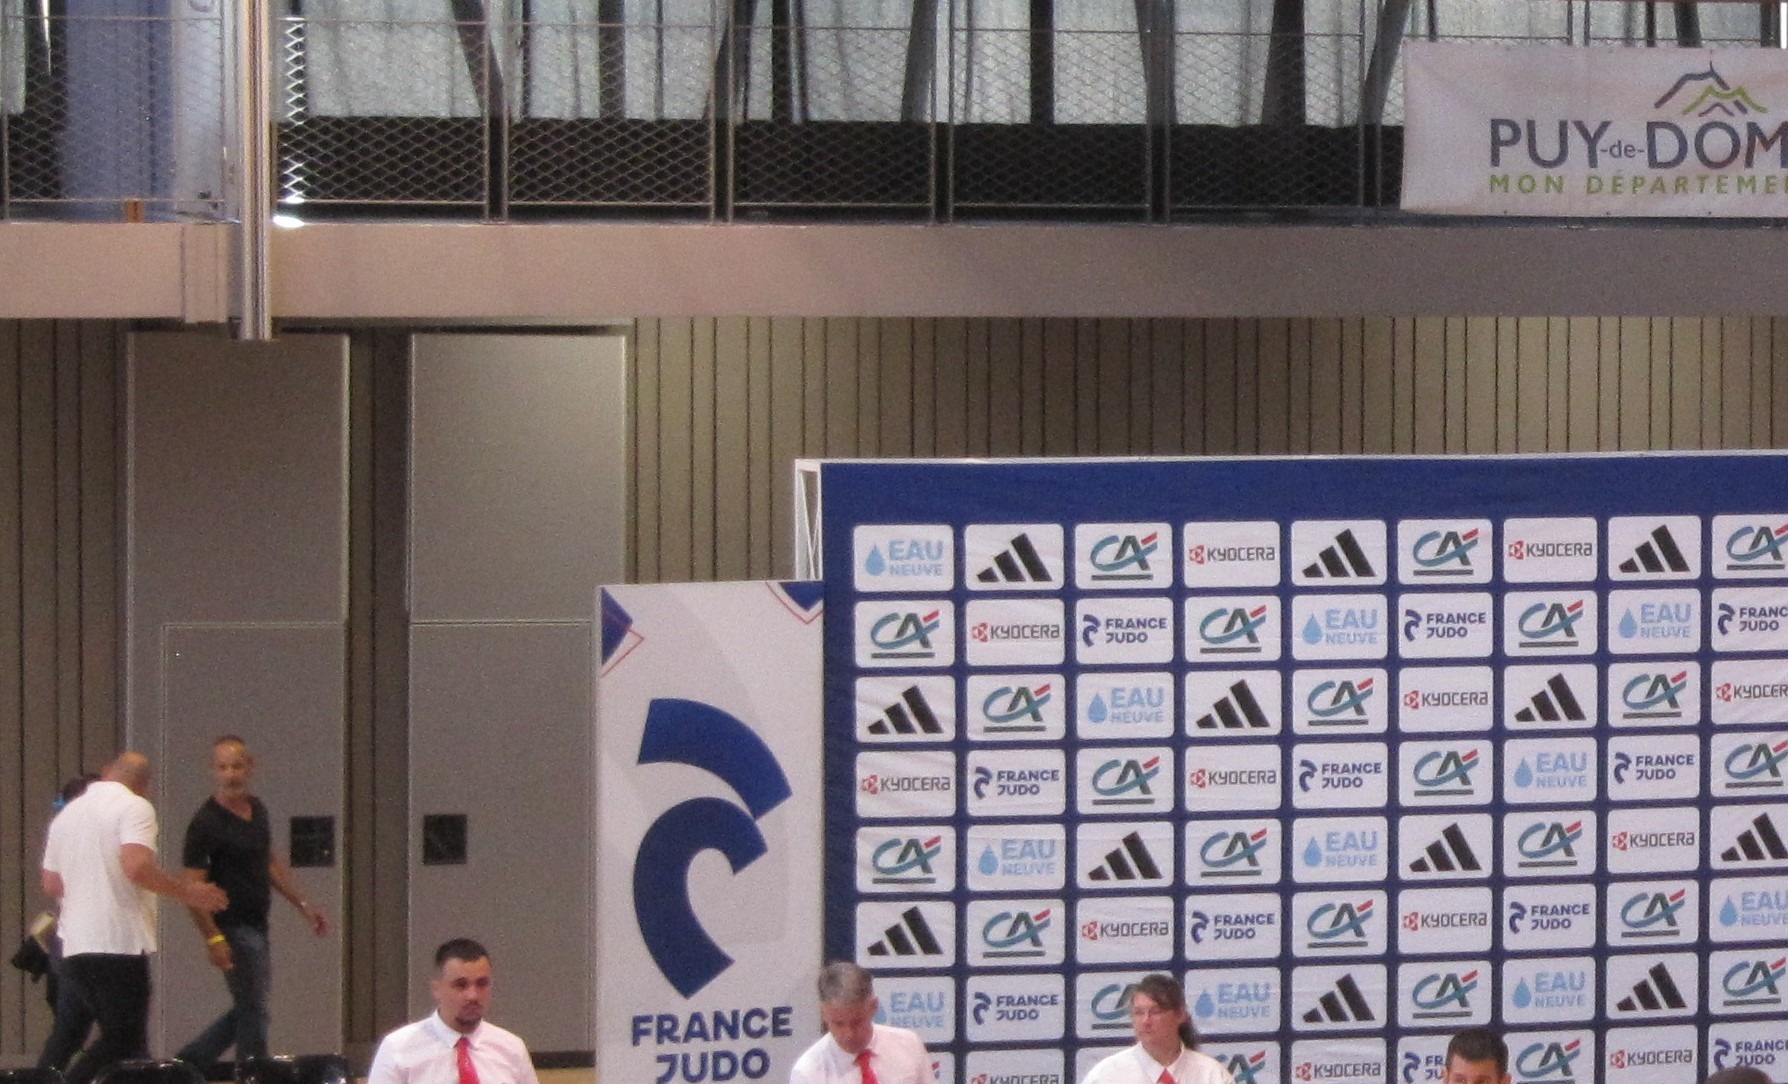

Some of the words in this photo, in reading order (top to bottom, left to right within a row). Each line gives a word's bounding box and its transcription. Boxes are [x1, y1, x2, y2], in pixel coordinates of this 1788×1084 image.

[1489, 174, 1565, 195] MON
[889, 540, 943, 561] EAU
[889, 564, 942, 577] NEUVE
[1326, 610, 1377, 629] EAU
[1426, 612, 1486, 624] FRANCE
[1641, 604, 1691, 623] EAU
[1105, 618, 1166, 630] FRANCE
[1740, 621, 1779, 632] JUDO
[1106, 632, 1148, 644] JUDO
[1325, 632, 1378, 645] NEUVE
[1427, 627, 1468, 638] JUDO
[1640, 627, 1691, 639] NEUVE
[1111, 688, 1163, 708] EAU
[1536, 753, 1586, 773] EAU
[1636, 754, 1694, 767] FRANCE
[1322, 762, 1382, 775] FRANCE
[1636, 769, 1676, 780] JUDO
[996, 770, 1059, 782] FRANCE
[1536, 776, 1587, 788] NEUVE
[1322, 777, 1363, 789] JUDO
[997, 784, 1040, 796] JUDO
[1326, 832, 1377, 852] EAU
[1002, 840, 1055, 859] EAU
[1325, 855, 1377, 868] NEUVE
[1003, 862, 1054, 876] NEUVE
[1531, 904, 1589, 916] FRANCE
[1213, 913, 1274, 926] FRANCE
[1531, 918, 1572, 930] JUDO
[1214, 928, 1256, 940] JUDO
[1536, 972, 1584, 992] EAU
[1218, 984, 1270, 1003] EAU
[891, 993, 944, 1013] EAU
[996, 994, 1058, 1007] FRANCE
[1535, 996, 1584, 1008] NEUVE
[997, 1009, 1039, 1021] JUDO
[1217, 1006, 1270, 1019] NEUVE
[631, 1006, 794, 1048] FRANCE
[891, 1016, 943, 1028] NEUVE
[1735, 1054, 1776, 1067] JUDO
